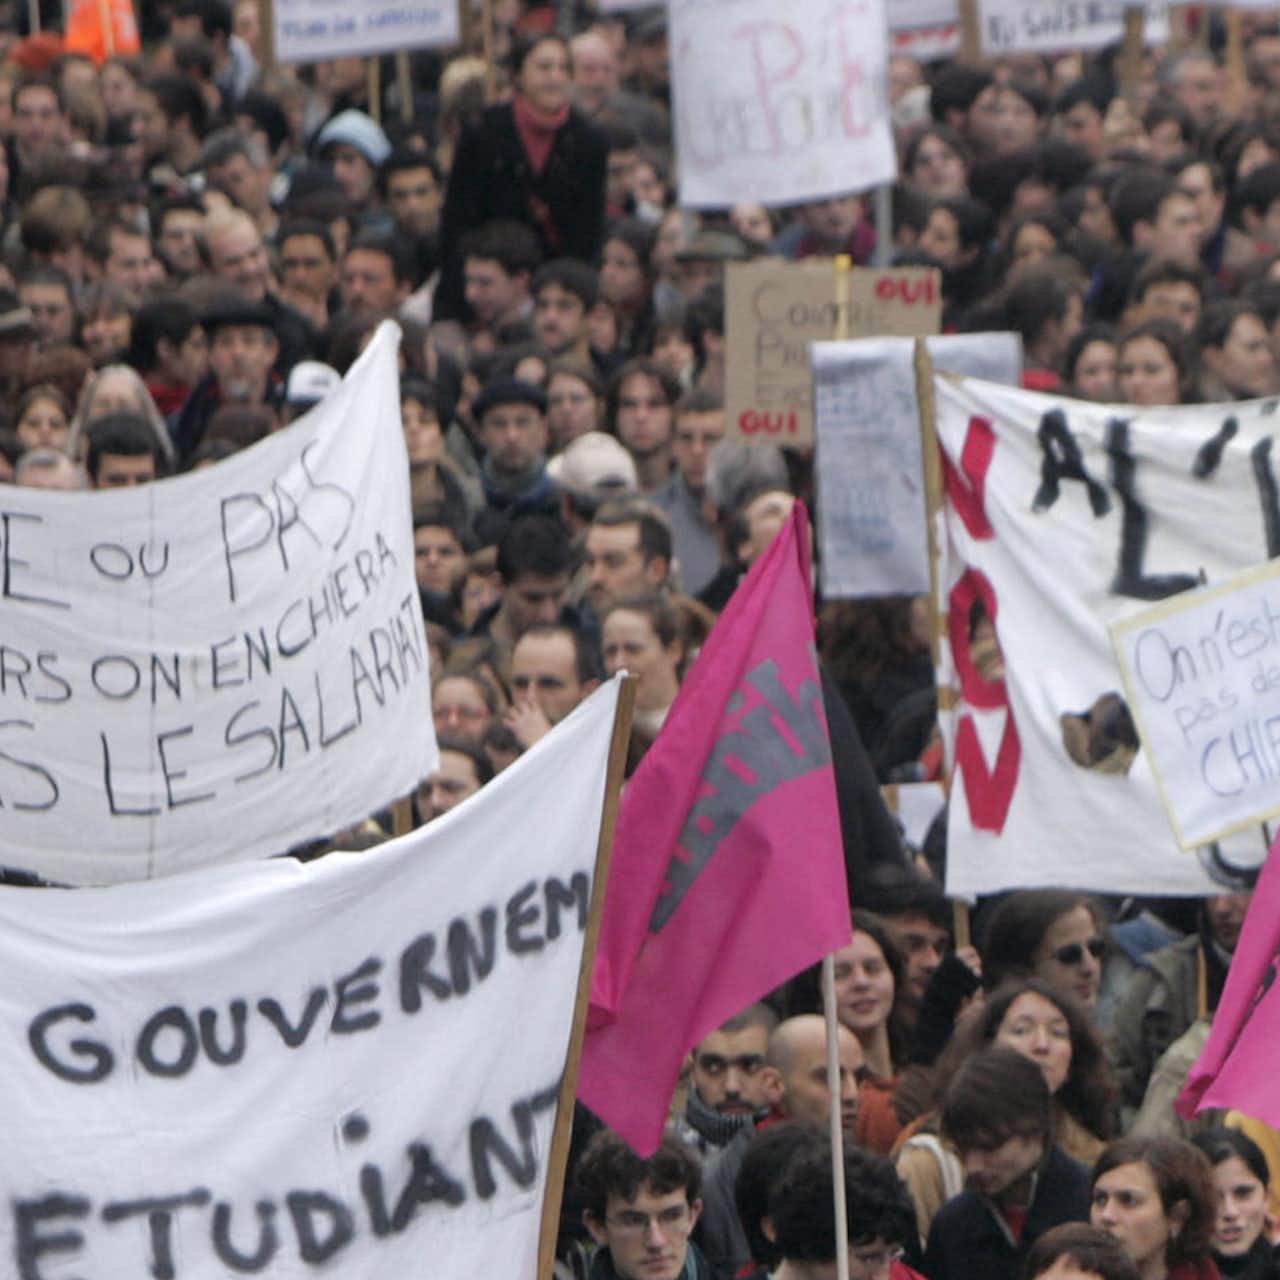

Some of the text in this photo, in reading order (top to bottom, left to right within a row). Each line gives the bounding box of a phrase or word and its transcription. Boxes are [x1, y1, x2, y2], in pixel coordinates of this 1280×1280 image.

[873, 269, 937, 304] OUI
[738, 405, 800, 437] OUI
[1032, 408, 1110, 520] A
[90, 541, 170, 580] OU
[219, 438, 355, 602] PAS
[91, 653, 183, 704] ON
[211, 630, 271, 690] EN
[275, 531, 398, 657] CHIERA
[100, 724, 215, 817] LE
[28, 870, 588, 1084] GOUVERNEM
